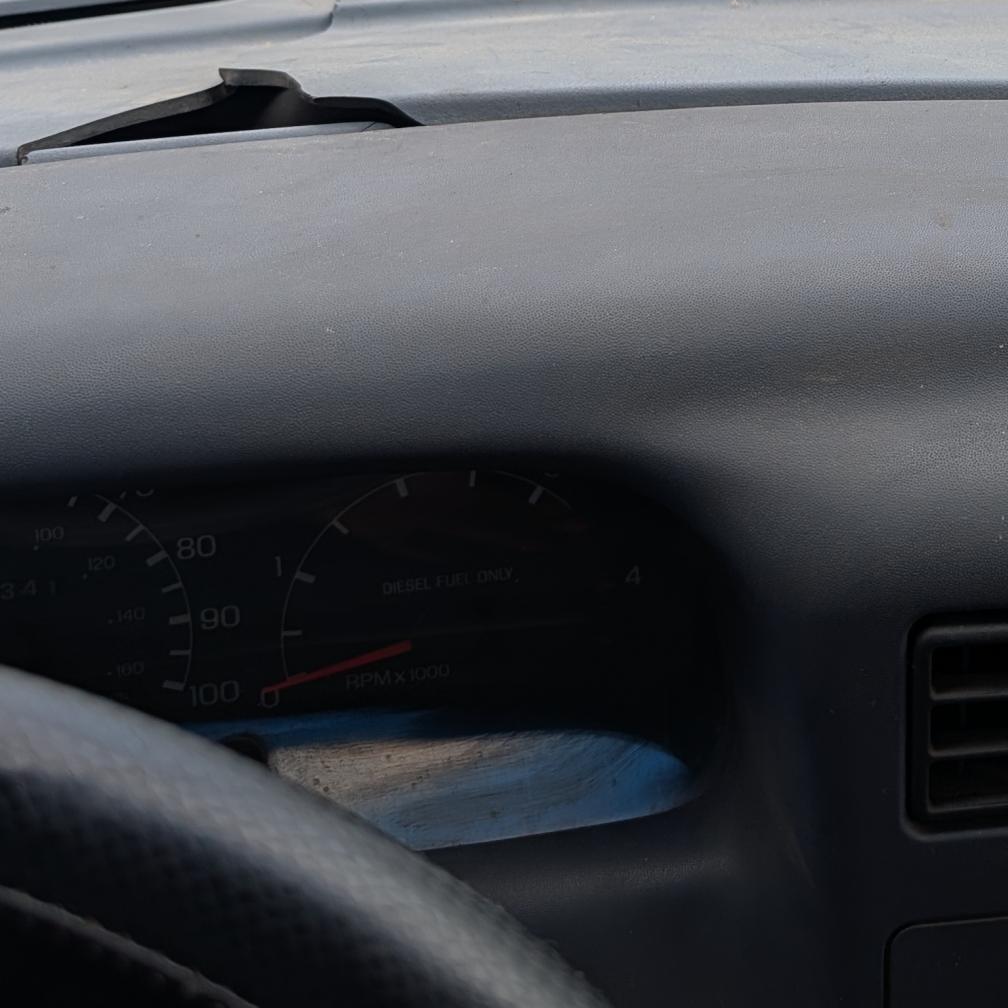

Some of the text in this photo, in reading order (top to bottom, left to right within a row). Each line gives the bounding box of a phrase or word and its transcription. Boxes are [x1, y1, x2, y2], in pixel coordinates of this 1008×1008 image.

[34, 525, 65, 542] 100
[176, 534, 217, 560] 80
[87, 555, 116, 571] 120
[274, 555, 282, 577] 1
[382, 576, 432, 596] DIESEL
[436, 571, 472, 587] FUEL
[624, 565, 642, 585] 4
[199, 604, 241, 630] 90
[345, 671, 392, 690] RPM
[189, 679, 241, 709] 100
